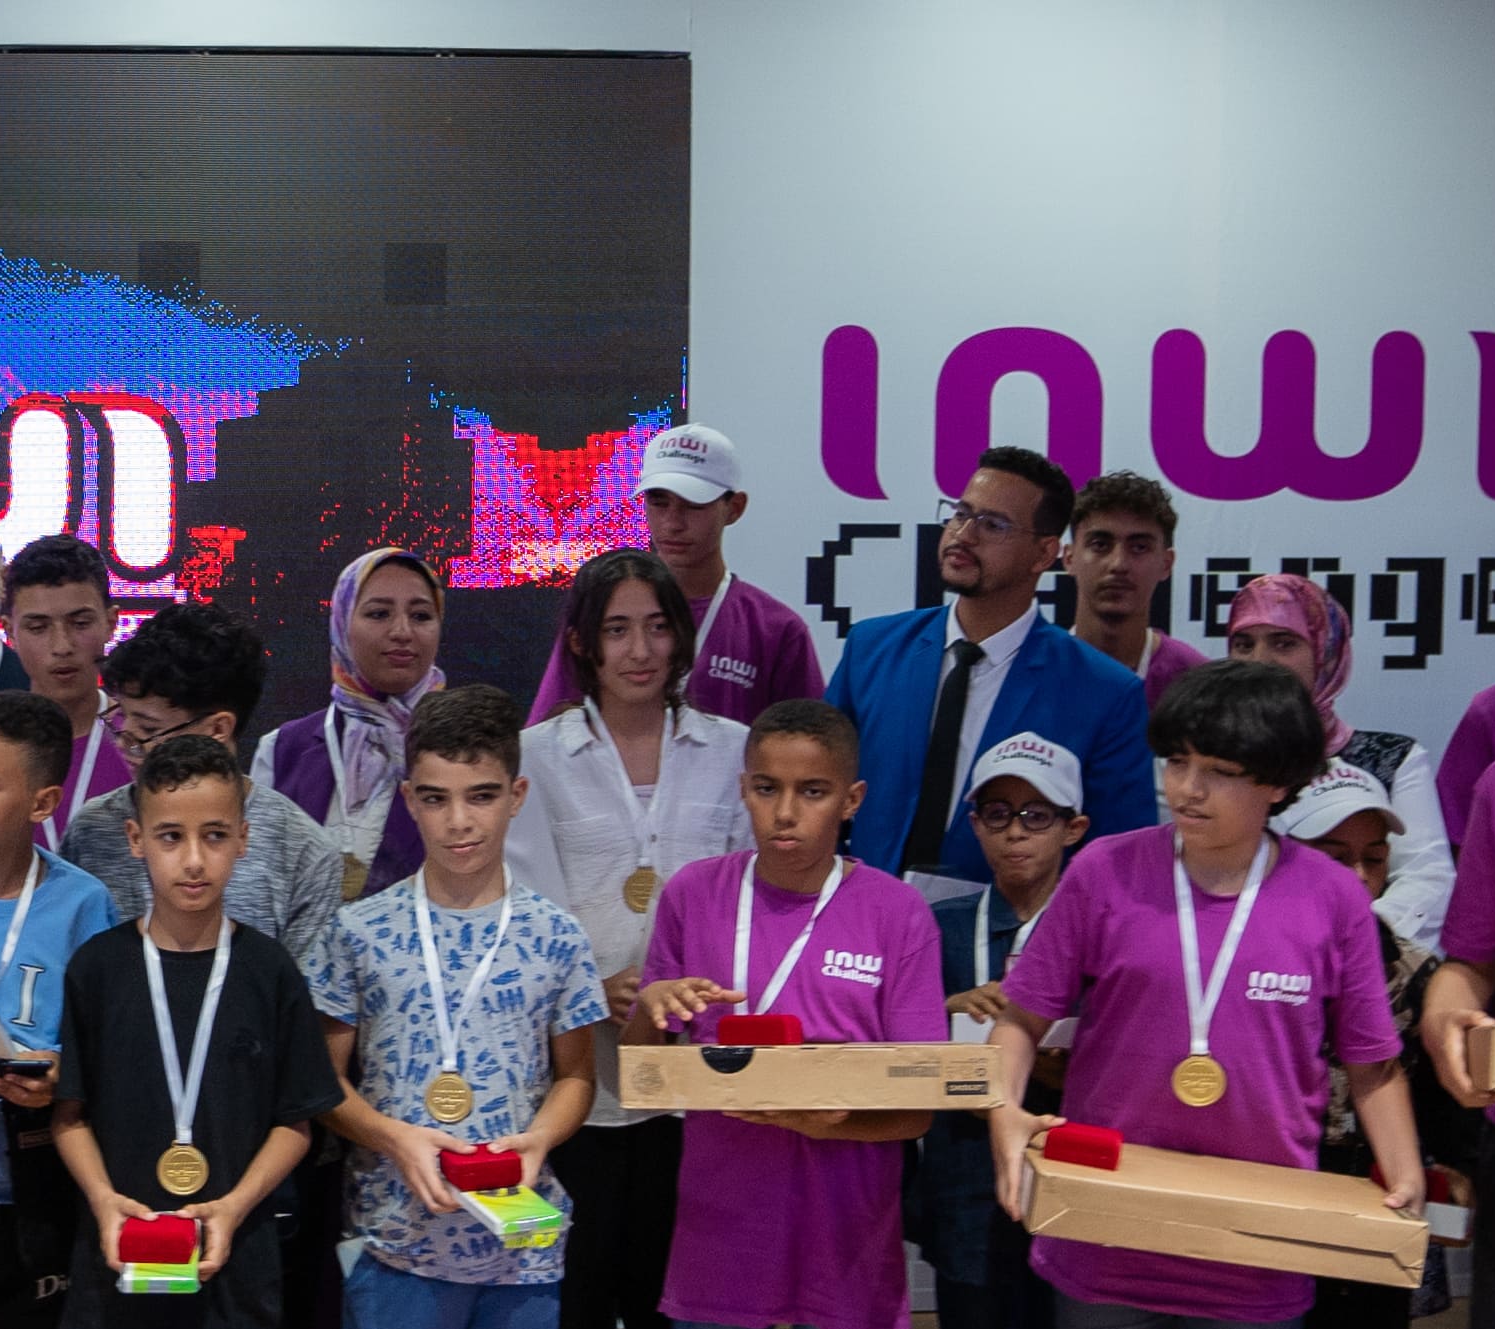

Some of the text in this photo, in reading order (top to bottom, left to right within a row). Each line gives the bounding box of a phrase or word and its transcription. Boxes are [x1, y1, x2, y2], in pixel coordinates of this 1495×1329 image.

[659, 437, 709, 453] inwi
[710, 655, 758, 679] inwi
[824, 949, 883, 973] inw
[1248, 971, 1312, 992] inwi
